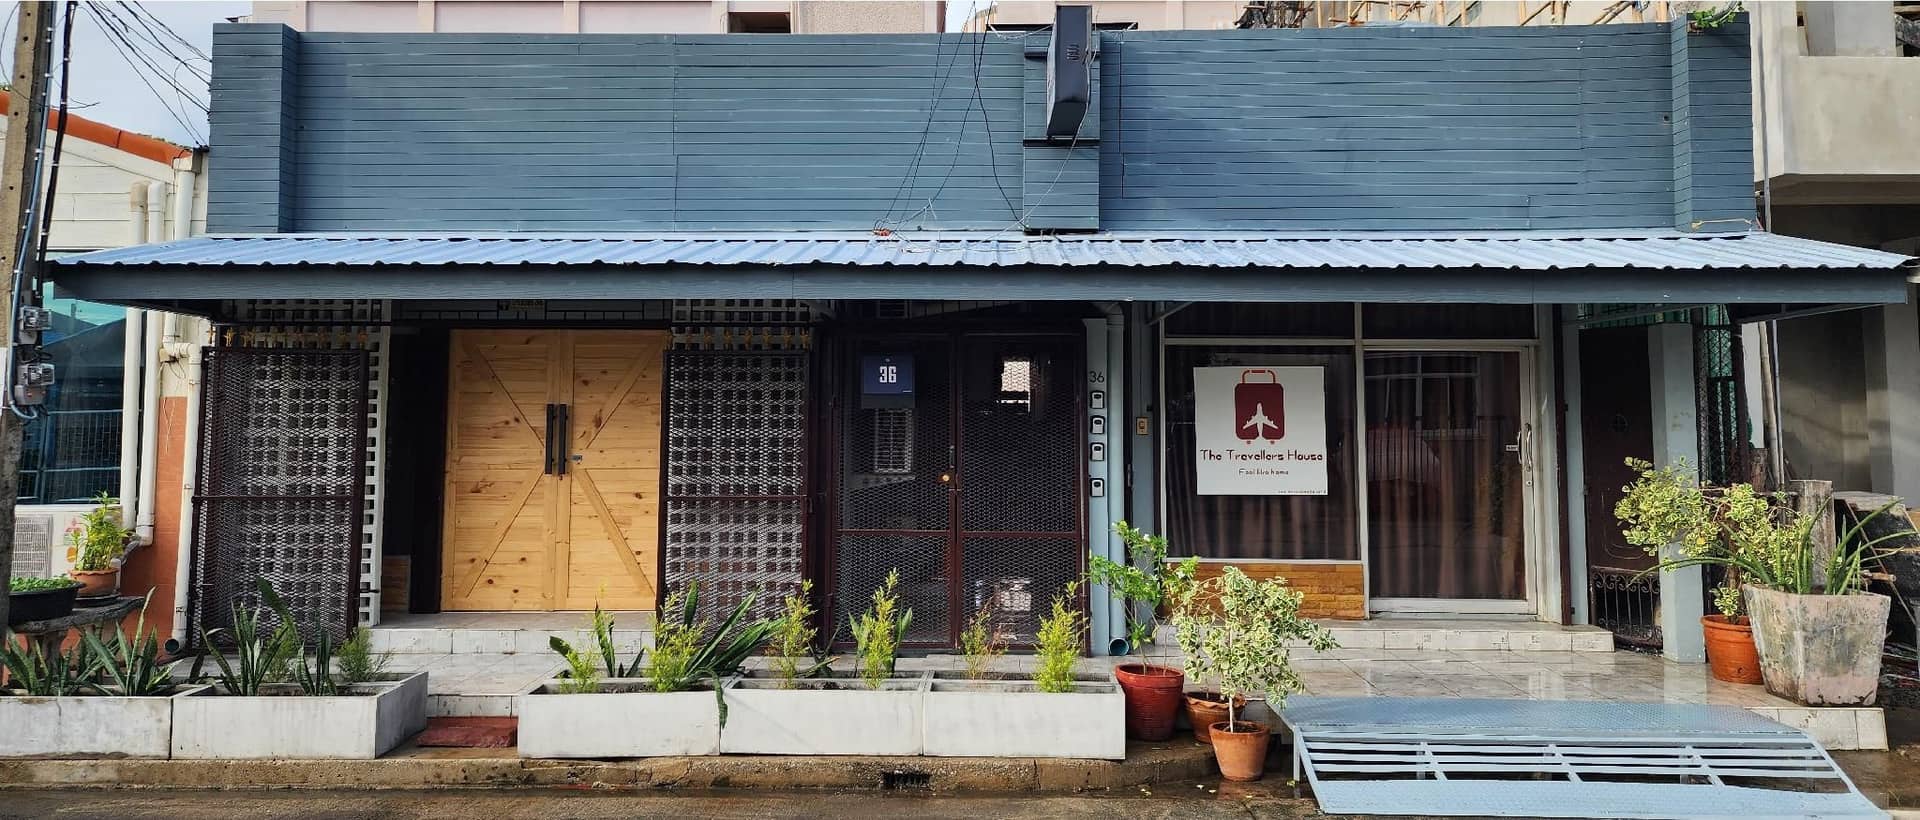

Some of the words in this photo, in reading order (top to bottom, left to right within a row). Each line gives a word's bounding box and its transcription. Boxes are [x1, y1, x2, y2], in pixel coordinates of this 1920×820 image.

[880, 366, 896, 383] 36
[1089, 371, 1104, 383] 36
[1200, 449, 1222, 461] The
[1287, 449, 1323, 461] House
